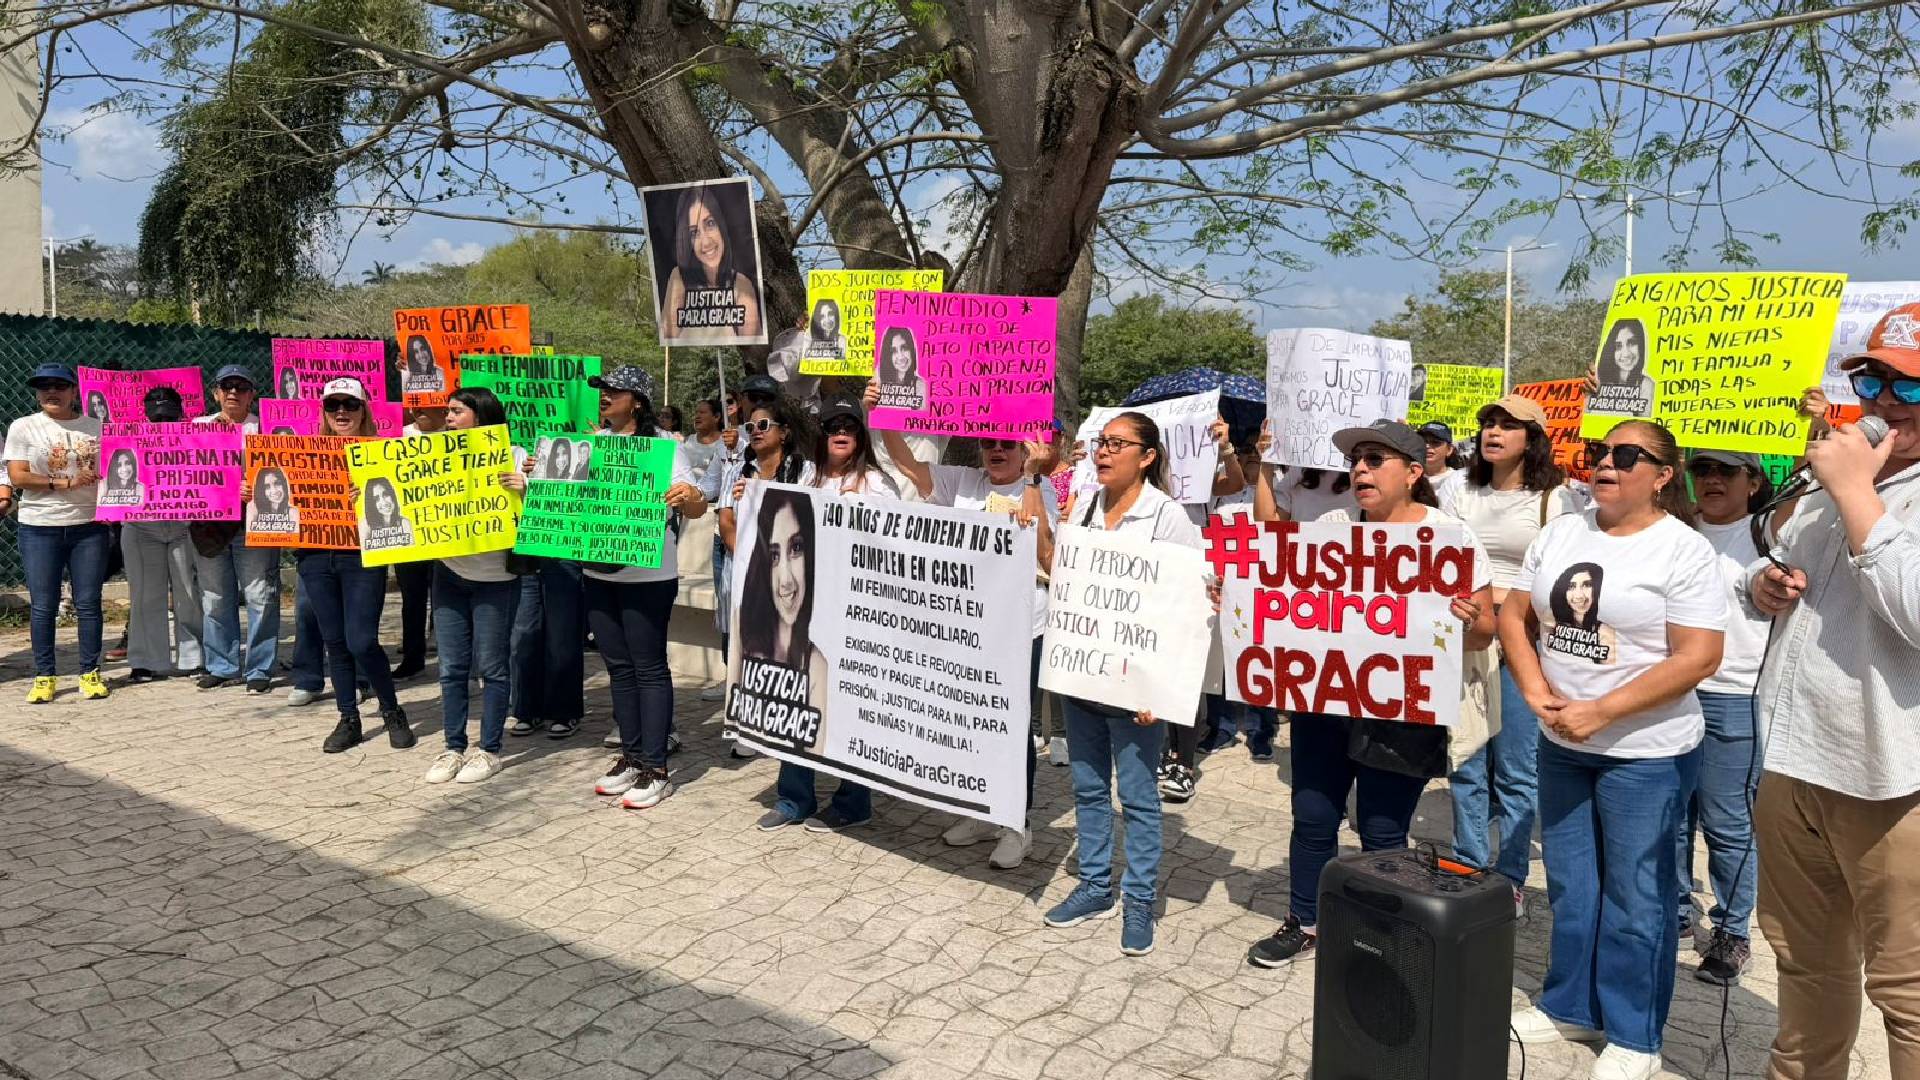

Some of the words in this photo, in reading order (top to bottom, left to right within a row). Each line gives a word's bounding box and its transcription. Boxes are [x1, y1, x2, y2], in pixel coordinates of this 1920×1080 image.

[811, 273, 841, 288] DOS
[845, 273, 904, 287] JUICIOS
[912, 273, 938, 286] CON
[686, 290, 733, 309] JUSTICIA
[1613, 279, 1732, 308] EXIGIMOS
[1741, 277, 1844, 301] JUSTICIA
[878, 292, 1007, 318] FEMINICIDIO
[396, 311, 431, 331] POR
[441, 306, 519, 333] GRACE
[678, 308, 708, 326] PARA
[710, 307, 744, 325] GRACE
[1657, 304, 1711, 330] PARA
[1721, 305, 1745, 322] MI
[1757, 302, 1815, 320] HIJA
[927, 321, 986, 336] DELITO
[1000, 322, 1020, 334] DE
[442, 334, 463, 346] POR
[922, 341, 960, 357] ALTO
[970, 340, 1050, 356] IMPACTO
[1309, 333, 1335, 352] DE
[1656, 334, 1694, 353] MIS
[1706, 327, 1783, 349] NIETAS
[502, 356, 587, 380] FEMINICIDA
[928, 360, 952, 378] LA
[962, 359, 1046, 377] CONDENA
[1661, 359, 1684, 376] MI
[1693, 353, 1772, 372] FAMILIA
[1321, 358, 1409, 400] JUSTICIA
[1659, 378, 1712, 396] TODAS
[1721, 376, 1757, 392] LAS
[496, 381, 511, 394] DE
[516, 381, 565, 399] GRACE
[880, 383, 915, 396] JUSTICIA
[929, 381, 953, 397] ES
[959, 381, 980, 396] EN
[1600, 386, 1640, 399] JUSTICIA
[546, 403, 557, 417] A
[896, 396, 922, 408] GRACE
[929, 401, 954, 417] NO
[961, 402, 990, 417] EN
[1296, 388, 1364, 418] GRACE
[1589, 398, 1614, 410] PARA
[1615, 399, 1647, 412] GRACE
[1660, 399, 1737, 413] MUJERES
[269, 404, 309, 420] ALTO
[181, 422, 237, 434] FEMINICIDA
[169, 436, 182, 446] LA
[350, 446, 378, 467] EL
[383, 435, 432, 460] CASO
[442, 434, 469, 454] DE
[594, 435, 630, 450] JUSTICIA
[630, 436, 650, 451] PARA
[144, 450, 219, 466] CONDENA
[223, 450, 242, 466] EN
[250, 452, 349, 471] MAGISTRA
[396, 457, 451, 483] GRACE
[460, 448, 509, 470] TIENE
[156, 470, 224, 485] PRISION
[288, 471, 339, 480] ORDENEN
[642, 472, 655, 490] MI
[184, 489, 205, 499] AL
[290, 484, 344, 494] CAMBIO
[403, 479, 465, 506] NOMBRE
[143, 501, 208, 511] ARRAIGO
[293, 497, 343, 510] MEDIDA
[414, 494, 508, 525] FEMINICIDIO
[250, 521, 272, 531] PARA
[273, 521, 296, 531] GRACE
[258, 513, 289, 521] JUSTICIA
[299, 524, 360, 546] PRISION
[371, 527, 404, 539] JUSTICIA
[415, 516, 504, 545] JUSTICIA
[823, 502, 842, 527] ¡40
[848, 502, 880, 534] AÑOS
[883, 512, 901, 538] DE
[905, 515, 965, 549] CONDENA
[969, 524, 989, 551] NO
[995, 528, 1013, 555] SE
[365, 538, 387, 549] PARA
[388, 534, 410, 547] GRACE
[630, 539, 656, 552] PARA
[588, 550, 638, 562] FAMILIA
[1058, 544, 1079, 570] NI
[1090, 548, 1159, 584] PERDON
[1201, 511, 1475, 598] #Justicia
[851, 543, 905, 578] CUMPLEN
[911, 555, 925, 582] EN
[932, 560, 974, 590] CASA!
[851, 576, 862, 593] MI
[866, 579, 926, 607] FEMINICIDA
[930, 593, 962, 615] ESTÁ
[967, 600, 984, 618] EN
[1054, 583, 1069, 602] NI
[1084, 584, 1140, 613] OLVIDO
[846, 604, 898, 628] ARRAIGO
[1253, 587, 1408, 645] para
[1114, 621, 1157, 652] PARA
[1555, 625, 1598, 644] JUSTICIA
[1548, 635, 1571, 653] PARA
[1572, 643, 1608, 659] GRACE
[846, 636, 890, 658] EXIGIMOS
[892, 647, 913, 664] QUE
[916, 653, 927, 666] LE
[930, 656, 983, 682] REVOQUEN
[985, 671, 1002, 685] EL
[1049, 644, 1117, 677] GRACE
[742, 659, 808, 704] JUSTICIA
[839, 657, 878, 678] AMPARO
[881, 668, 887, 680] Y
[889, 669, 922, 690] PAGUE
[923, 679, 935, 693] LA
[937, 683, 989, 708] CONDENA
[992, 695, 1009, 711] EN
[1235, 645, 1435, 725] GRACE
[730, 688, 763, 728] PARA
[764, 701, 819, 742] GRACE
[882, 693, 925, 714] ¡JUSTICIA
[928, 704, 951, 724] PARA
[973, 716, 1008, 734] PARA
[858, 707, 876, 724] MIS
[877, 712, 906, 732] NIÑAS
[907, 722, 914, 735] Y
[916, 725, 925, 740] MI
[848, 736, 987, 793] #JusticiaParaGrace
